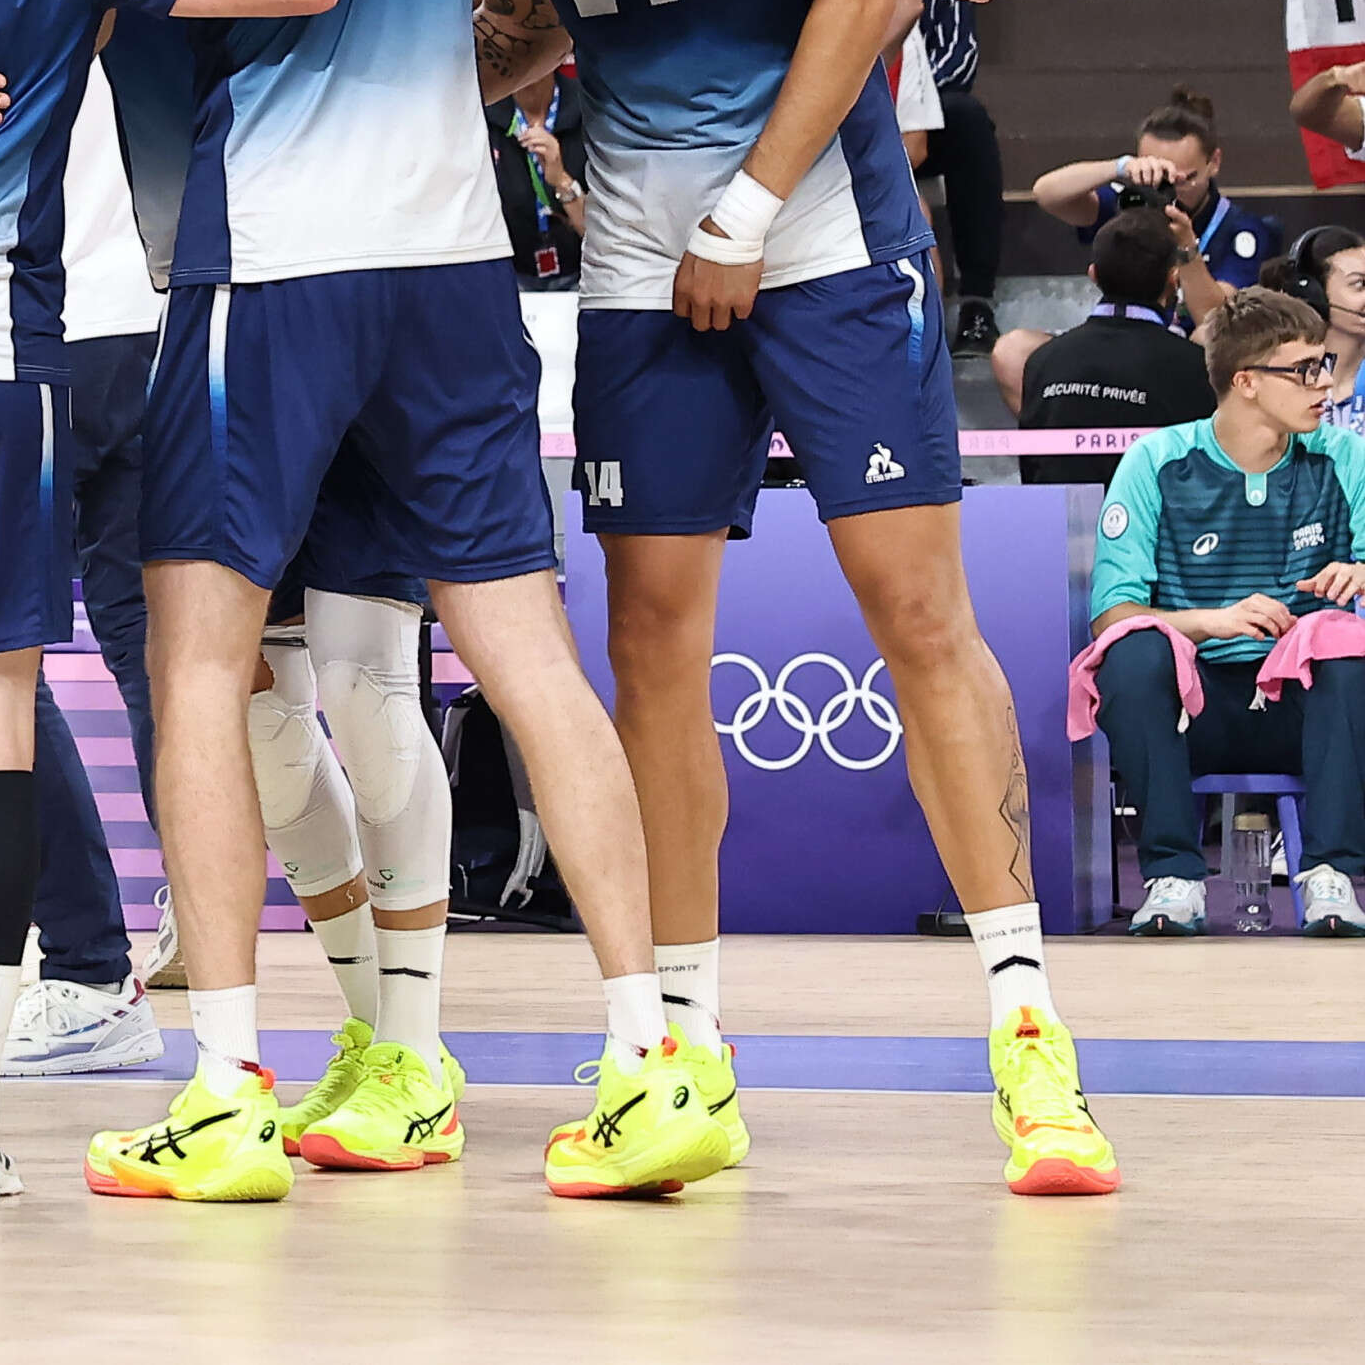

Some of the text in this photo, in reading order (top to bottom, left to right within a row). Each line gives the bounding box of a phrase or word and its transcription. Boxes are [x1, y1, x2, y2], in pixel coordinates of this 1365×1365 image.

[1102, 385, 1148, 405] PRIVÉE
[584, 461, 624, 506] 14
[1293, 522, 1324, 540] PARIS
